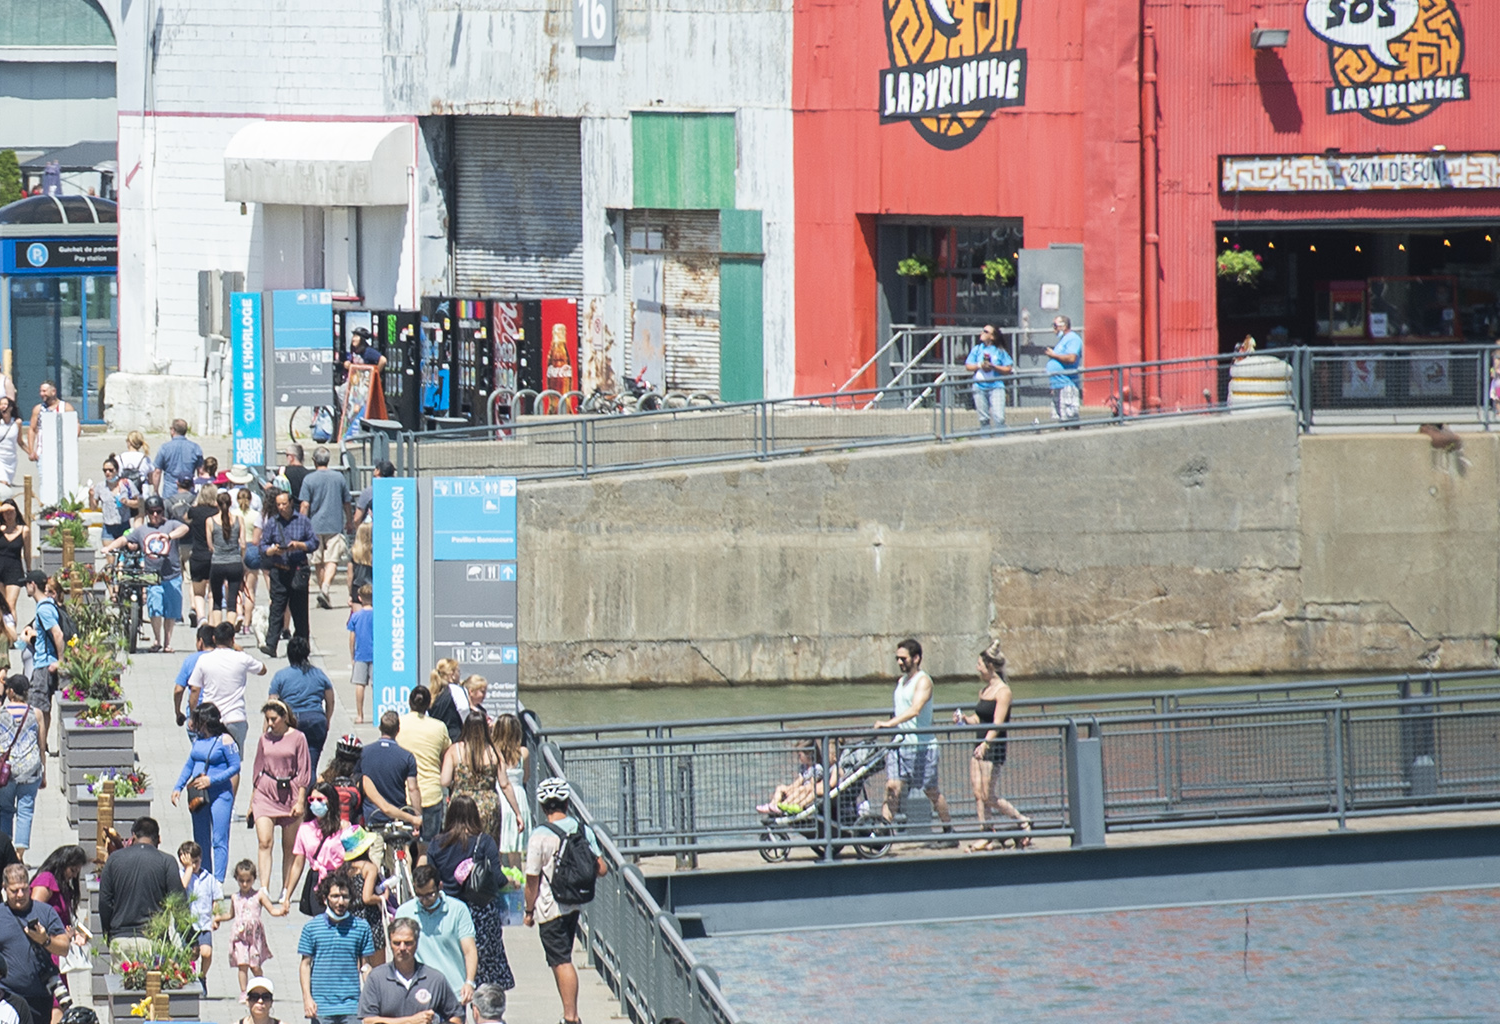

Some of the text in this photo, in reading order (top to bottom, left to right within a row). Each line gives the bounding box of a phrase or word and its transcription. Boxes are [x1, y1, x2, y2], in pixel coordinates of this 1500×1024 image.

[578, 0, 607, 39] 16
[1326, 0, 1396, 30] SOS
[884, 58, 1021, 116] LABYRINTHE
[1332, 77, 1465, 111] LABYRINTHE
[1350, 162, 1383, 182] 2KM
[1389, 162, 1408, 182] DE
[73, 254, 85, 262] Pay
[242, 299, 256, 422] QUAI DE L'HORLOGE
[236, 438, 262, 452] VIEUX
[236, 451, 262, 465] PORT
[392, 486, 405, 671] BONSECOURS THE BASIN
[459, 620, 474, 628] Quai
[485, 621, 514, 630] L'Horloge
[382, 686, 410, 705] OLD
